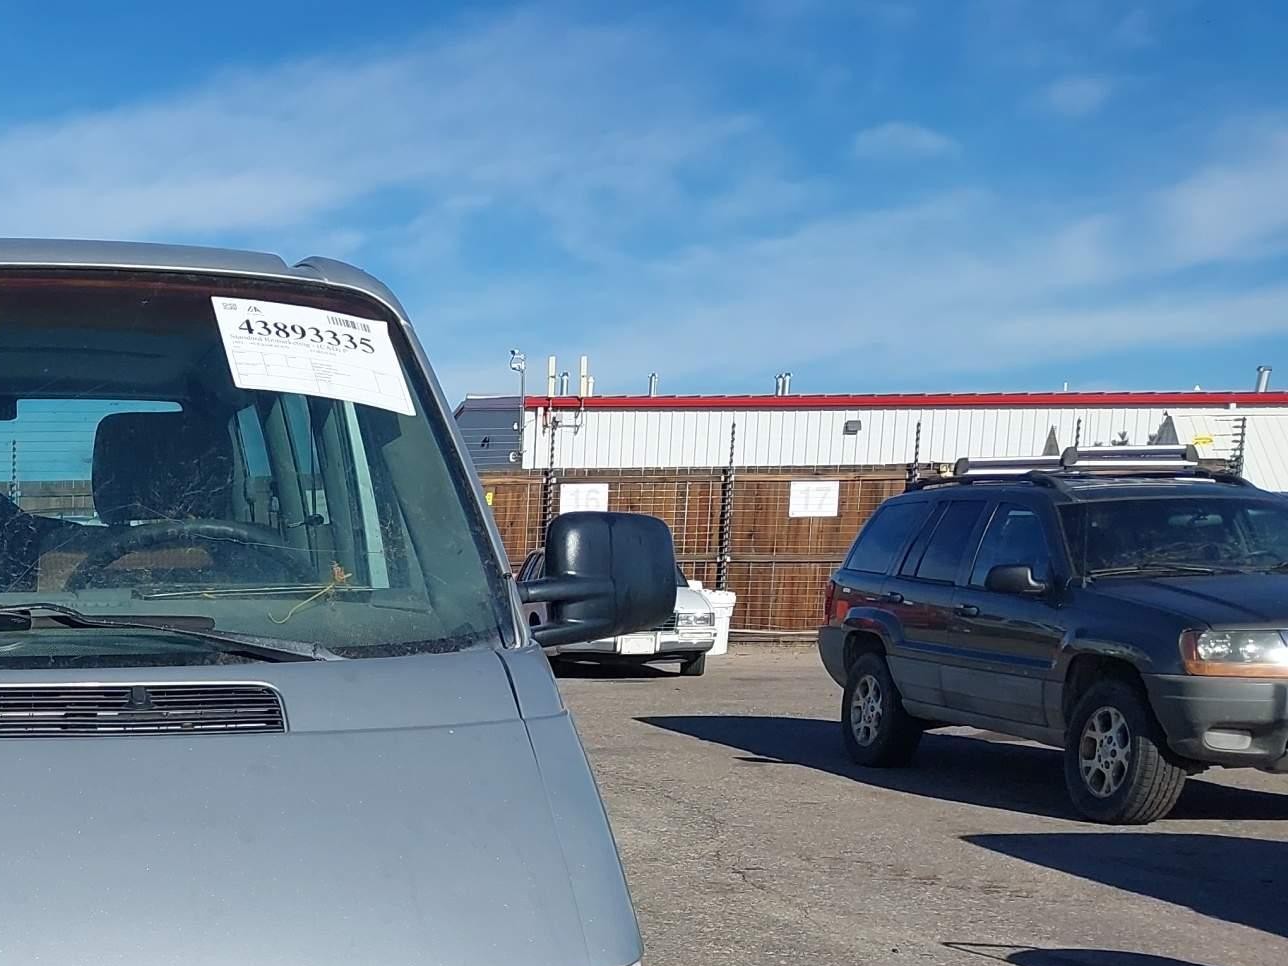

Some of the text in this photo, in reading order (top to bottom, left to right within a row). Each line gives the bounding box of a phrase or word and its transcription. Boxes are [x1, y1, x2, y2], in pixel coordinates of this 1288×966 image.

[238, 318, 376, 355] 43893335
[569, 487, 601, 509] 16
[800, 486, 832, 510] 17
